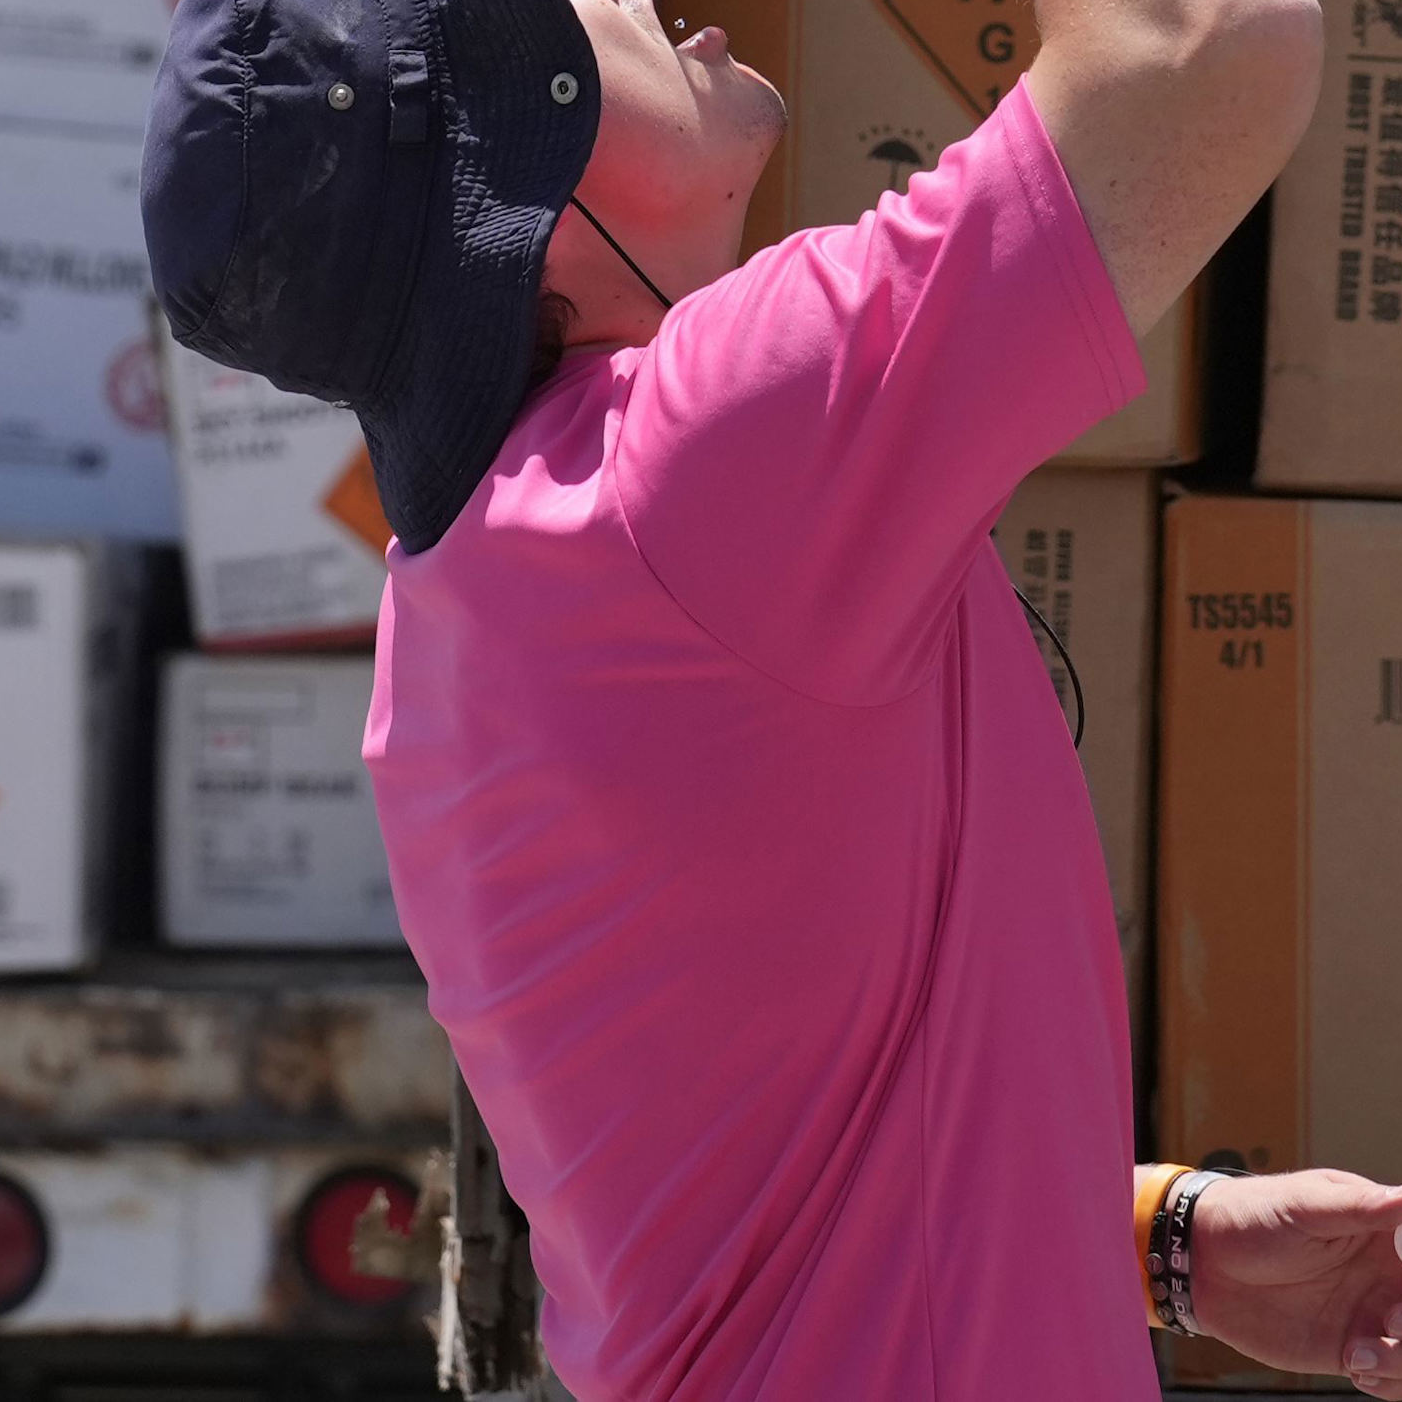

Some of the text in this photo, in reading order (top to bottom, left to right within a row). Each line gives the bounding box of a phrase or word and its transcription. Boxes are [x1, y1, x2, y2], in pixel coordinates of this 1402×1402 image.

[979, 22, 1016, 66] G
[1335, 72, 1373, 323] MOST TRUSTED BRAND
[1187, 593, 1295, 632] TS5545
[1219, 639, 1267, 670] 4/1
[1173, 1184, 1195, 1229] SAY
[1169, 1234, 1183, 1269] NO
[1170, 1276, 1183, 1294] 2
